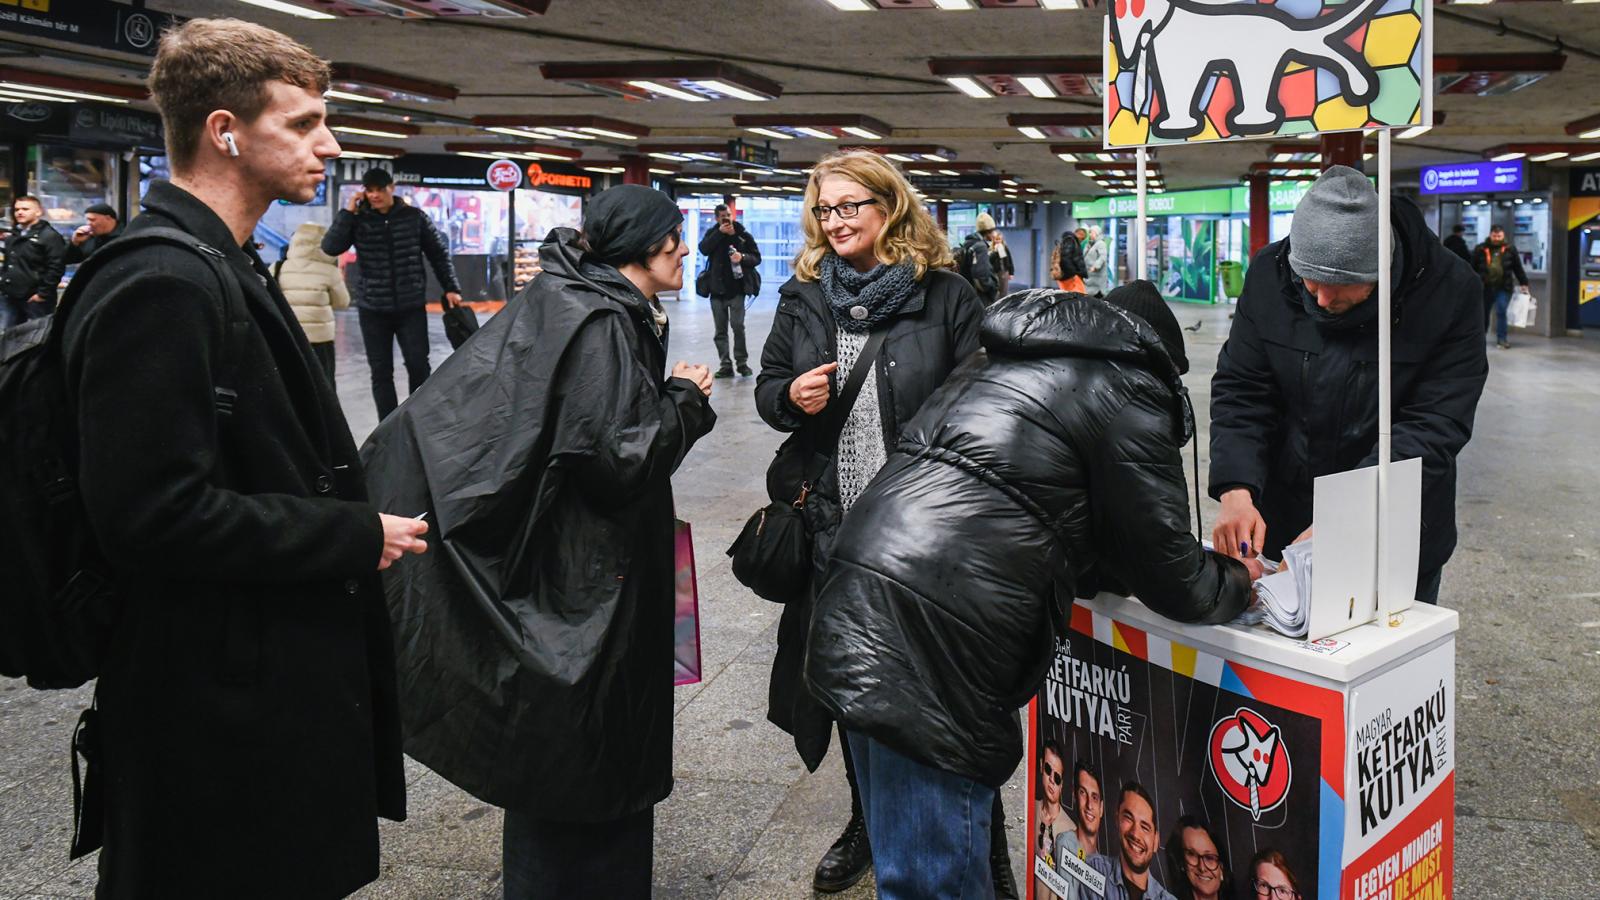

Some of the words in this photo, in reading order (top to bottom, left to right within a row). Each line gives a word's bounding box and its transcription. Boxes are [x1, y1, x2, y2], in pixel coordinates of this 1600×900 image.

[393, 172, 420, 182] pizza
[541, 172, 592, 188] FORNETTI
[1045, 678, 1116, 740] KUTYA
[1115, 703, 1133, 745] PÁRT
[1356, 707, 1393, 750] MAGYAR
[1357, 679, 1446, 789] KÉTFARKÚ
[1434, 724, 1447, 771] PÁRT
[1359, 737, 1435, 838] KUTYA
[1064, 855, 1085, 877] Sándor
[1085, 870, 1103, 891] Balázs
[1354, 851, 1400, 900] LEGYEN
[1402, 818, 1443, 873] MINDEN
[1395, 871, 1410, 900] DE
[1411, 846, 1443, 891] MOST
